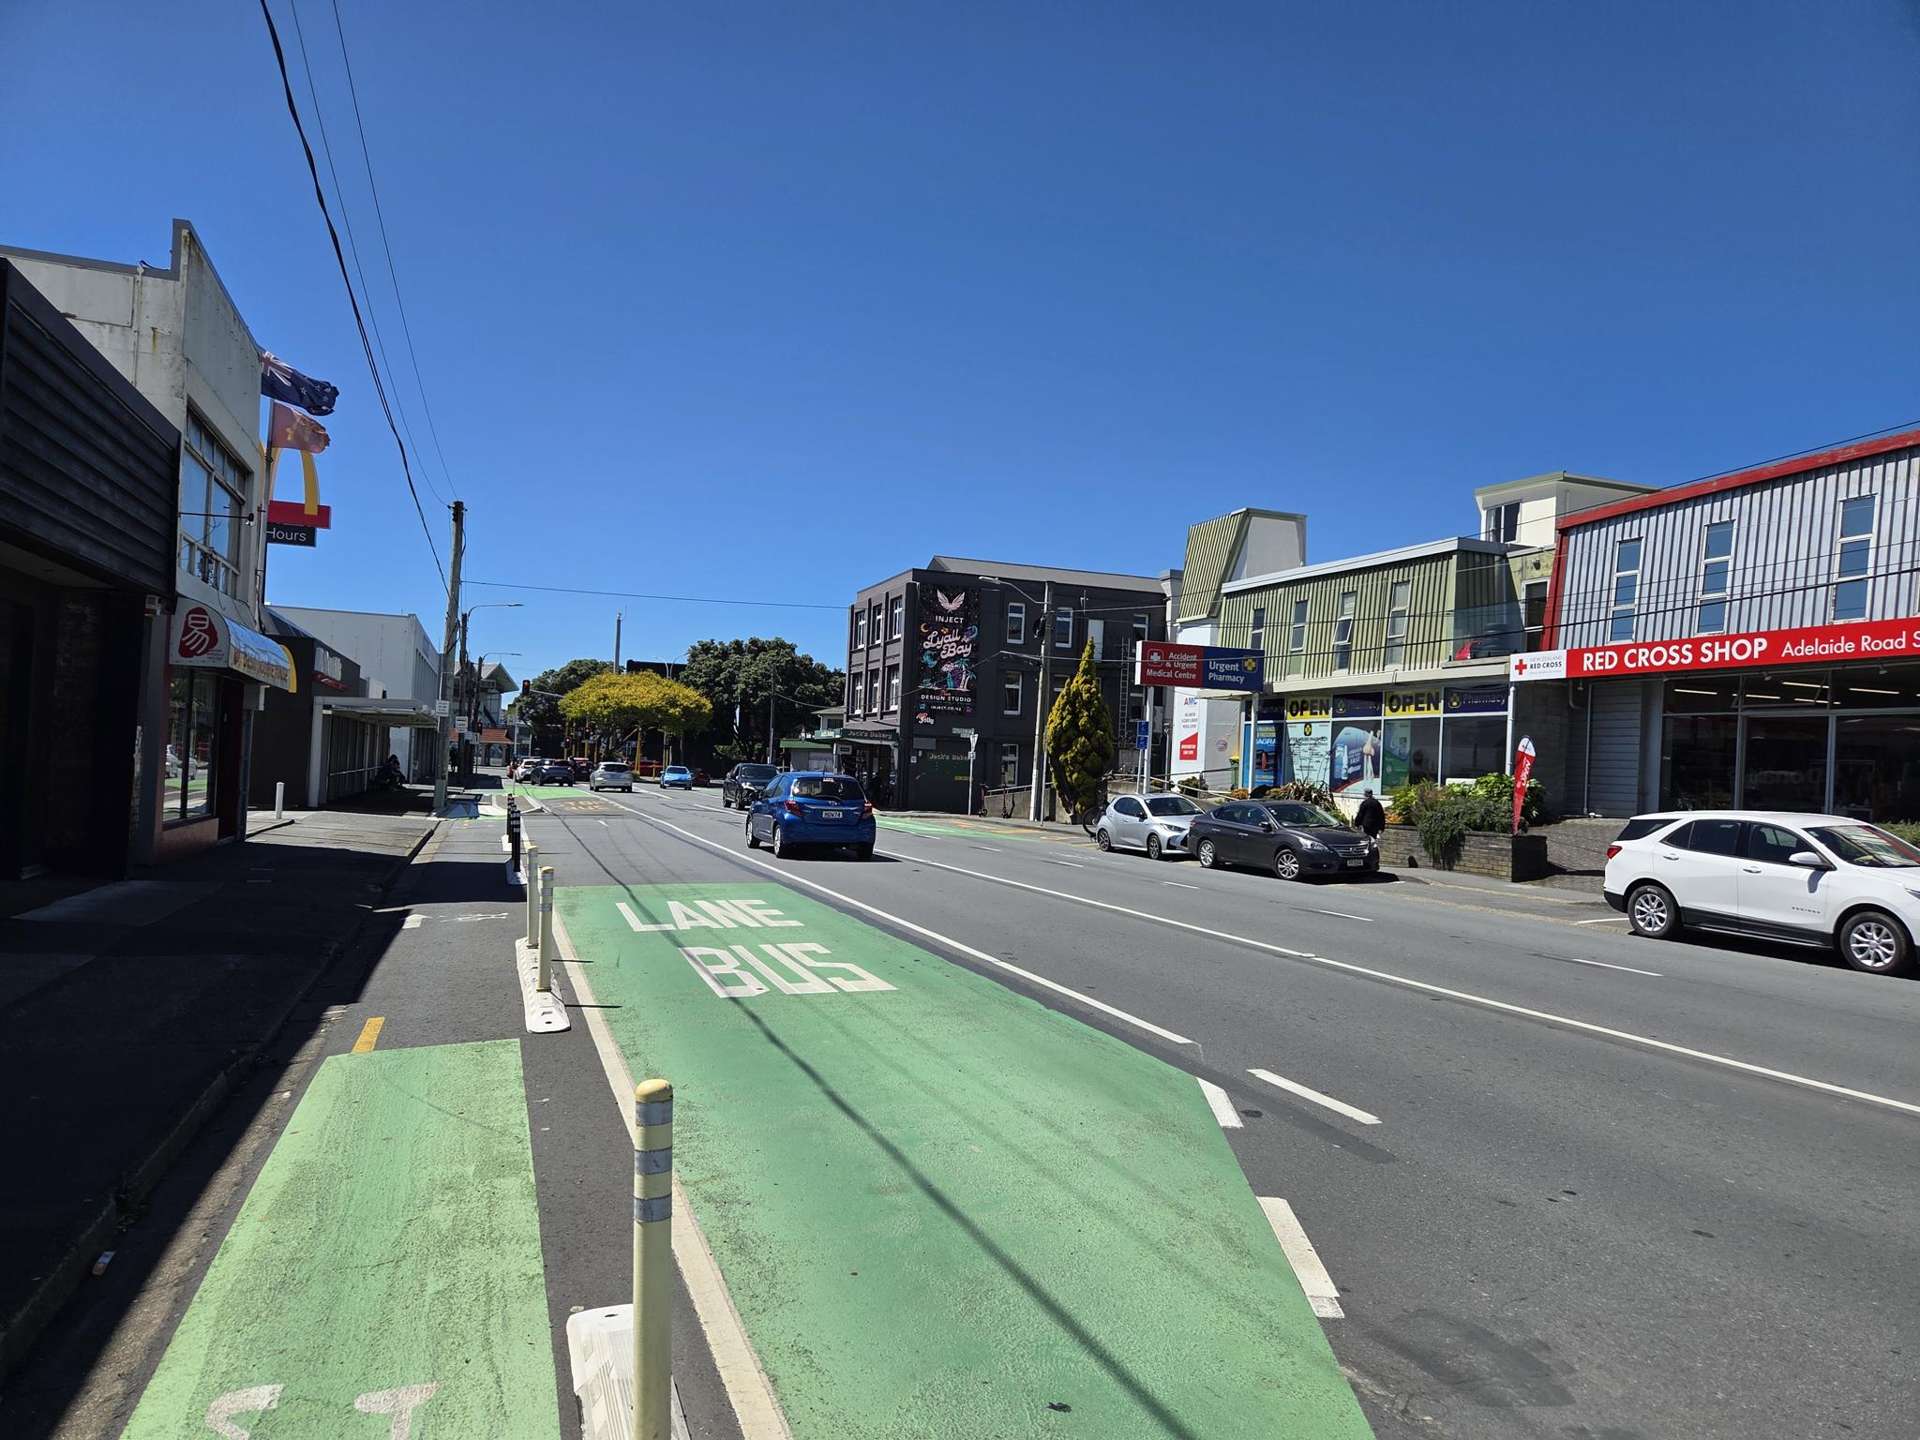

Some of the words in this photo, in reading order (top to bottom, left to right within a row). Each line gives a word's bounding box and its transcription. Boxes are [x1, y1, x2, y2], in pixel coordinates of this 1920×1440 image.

[935, 615, 964, 624] INJECT
[923, 629, 961, 649] Lyall
[940, 642, 972, 659] Bay
[1168, 652, 1197, 661] Accident
[1583, 651, 1618, 671] RED
[1624, 643, 1693, 668] CROSS
[1700, 637, 1767, 664] SHOP
[1781, 635, 1855, 657] Adelaide
[1861, 631, 1906, 652] Road
[1173, 661, 1197, 669] Urgent
[1208, 661, 1239, 672] Urgent
[1146, 668, 1173, 678] Medical
[1174, 671, 1197, 680] Centre
[1208, 672, 1245, 685] Pharmacy
[920, 694, 946, 702] DESIGN
[1388, 692, 1440, 713] OPEN
[1289, 700, 1330, 716] OPEN
[616, 900, 804, 932] LANE
[677, 942, 899, 998] BUS
